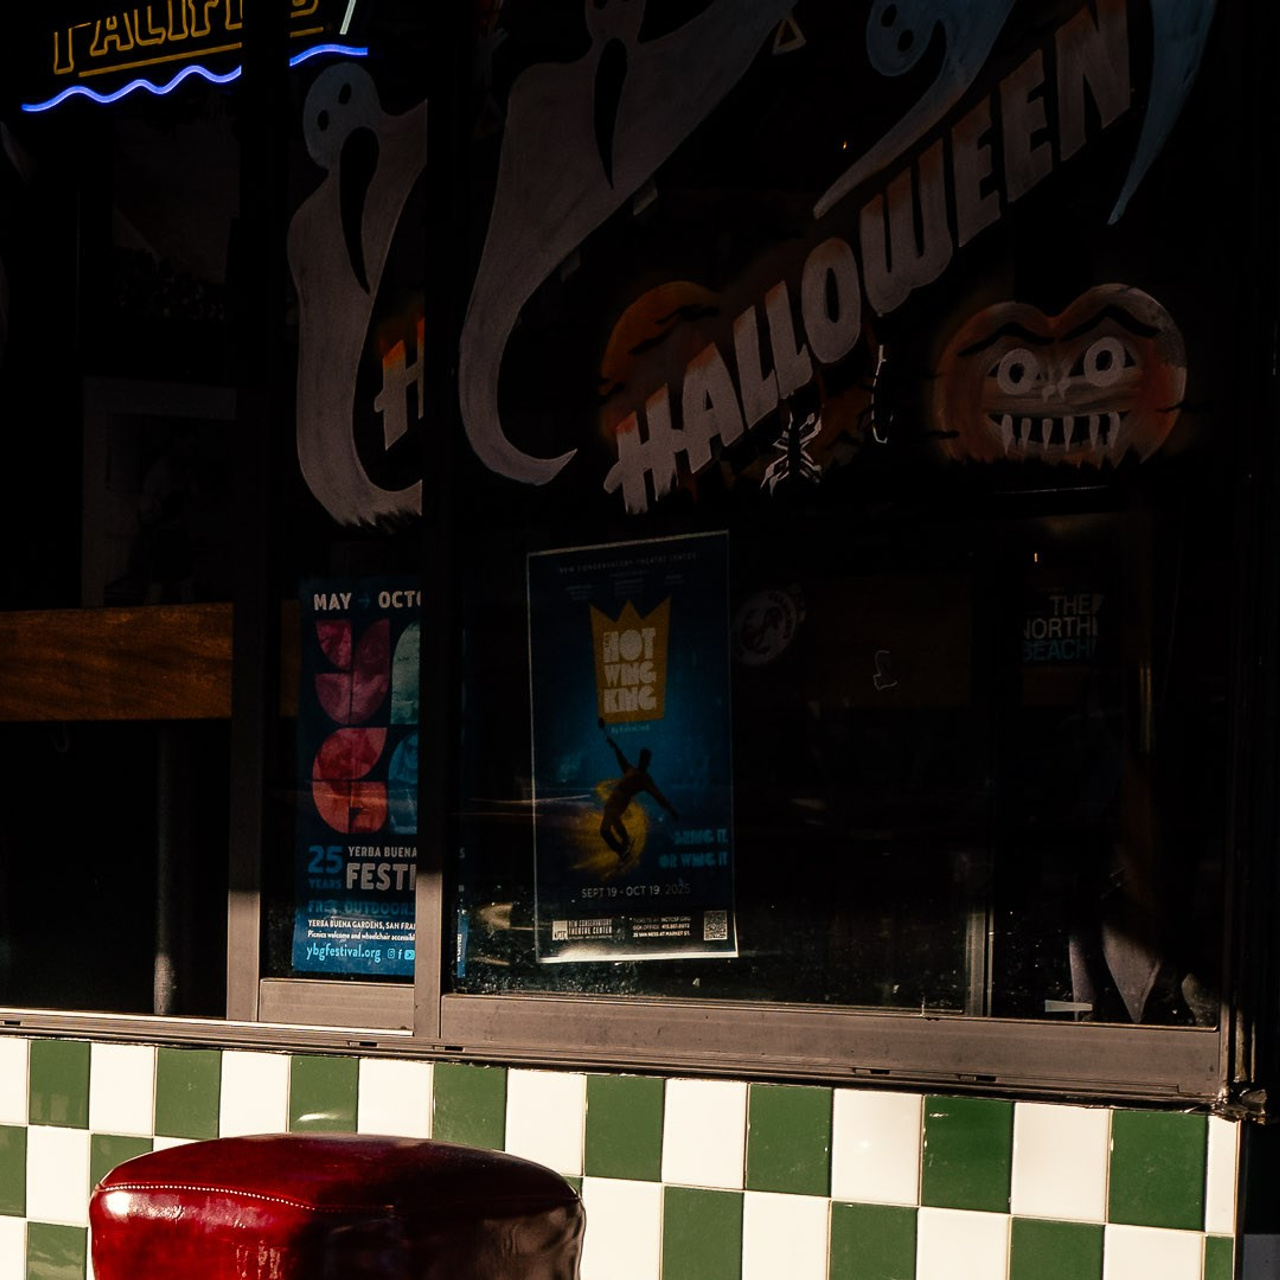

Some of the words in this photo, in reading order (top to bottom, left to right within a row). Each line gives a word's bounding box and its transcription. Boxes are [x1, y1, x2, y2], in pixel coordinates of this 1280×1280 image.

[602, 0, 1133, 517] HALLOWEEN
[313, 592, 352, 611] MAY
[602, 626, 657, 663] HOT
[604, 660, 658, 688] WING
[603, 685, 658, 714] KING
[307, 845, 344, 875] 25
[348, 846, 382, 858] YERBA
[383, 846, 418, 859] BUENA
[307, 877, 343, 890] YEARS
[581, 887, 605, 899] SEPT
[607, 886, 618, 898] 19
[626, 885, 646, 897] OCT
[664, 883, 692, 895] 2025
[308, 919, 329, 928] YERBA
[329, 919, 352, 929] BUENA
[385, 921, 400, 930] SAN
[306, 942, 381, 963] ybgfestival.org
